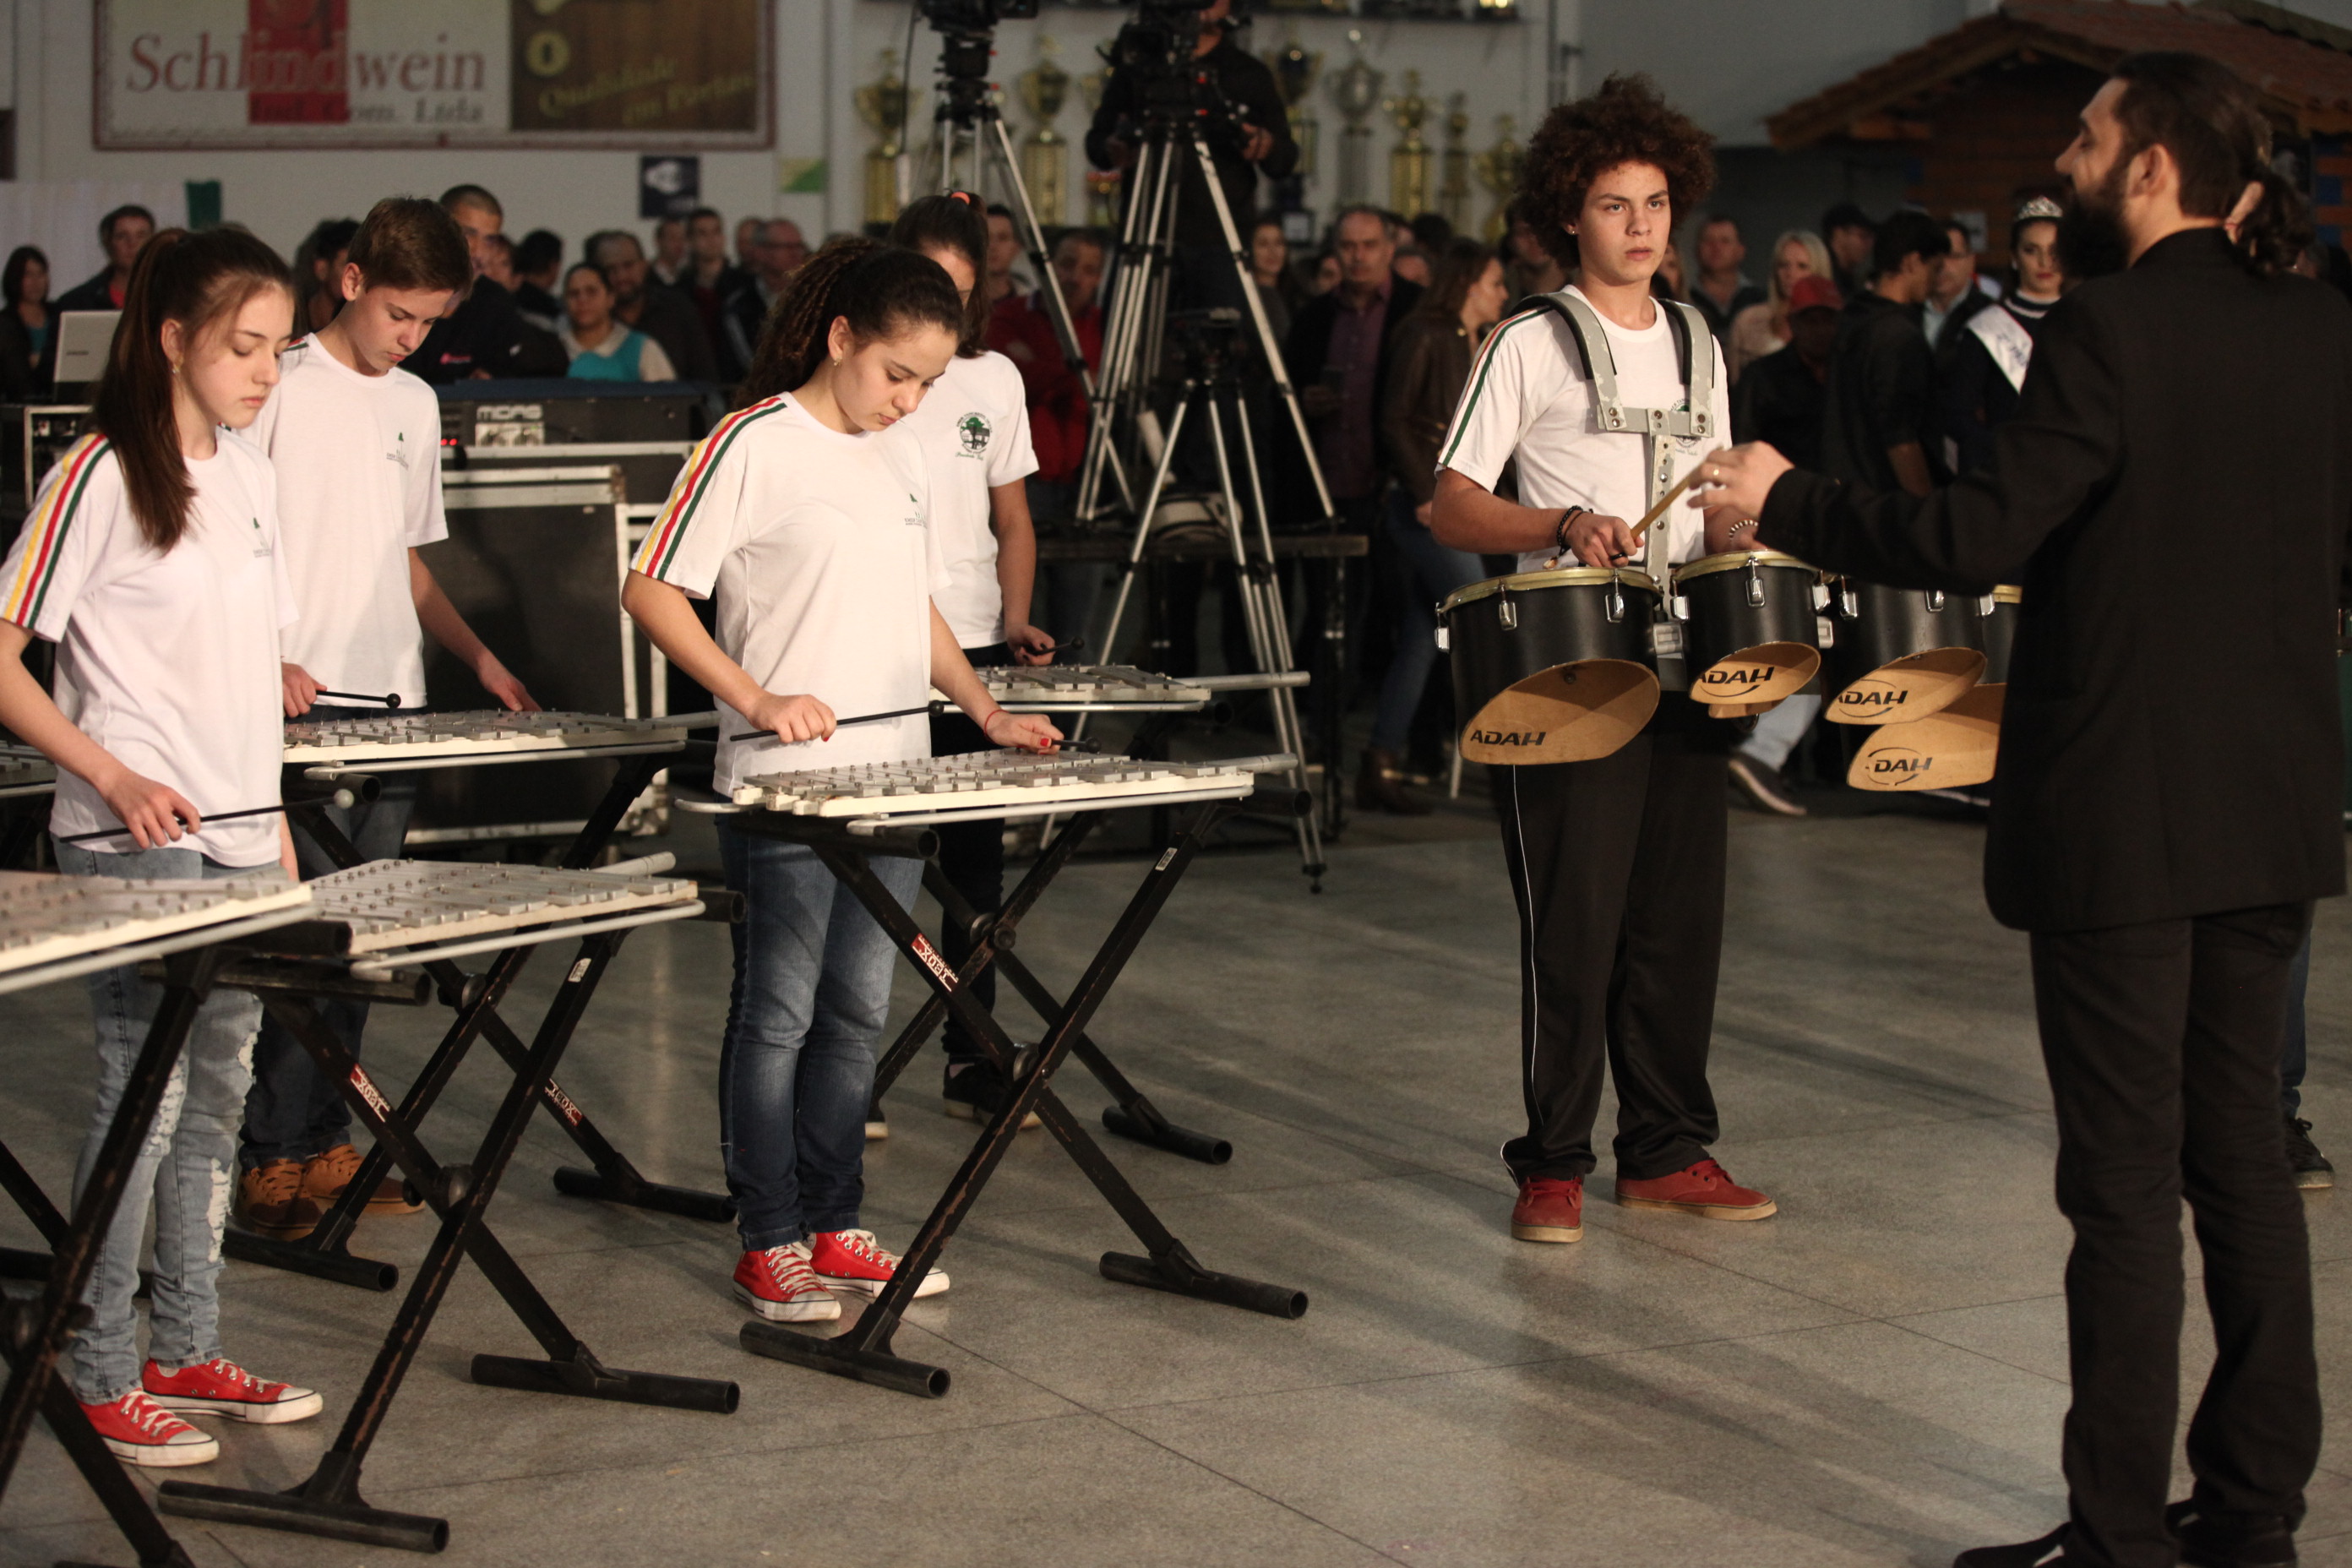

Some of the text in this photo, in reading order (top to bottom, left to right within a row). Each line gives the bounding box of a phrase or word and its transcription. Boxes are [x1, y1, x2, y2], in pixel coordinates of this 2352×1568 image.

[126, 30, 487, 93] Schlindwein
[1470, 729, 1547, 746] ADAH
[1865, 757, 1934, 773] DAH
[915, 939, 956, 989] IBOX
